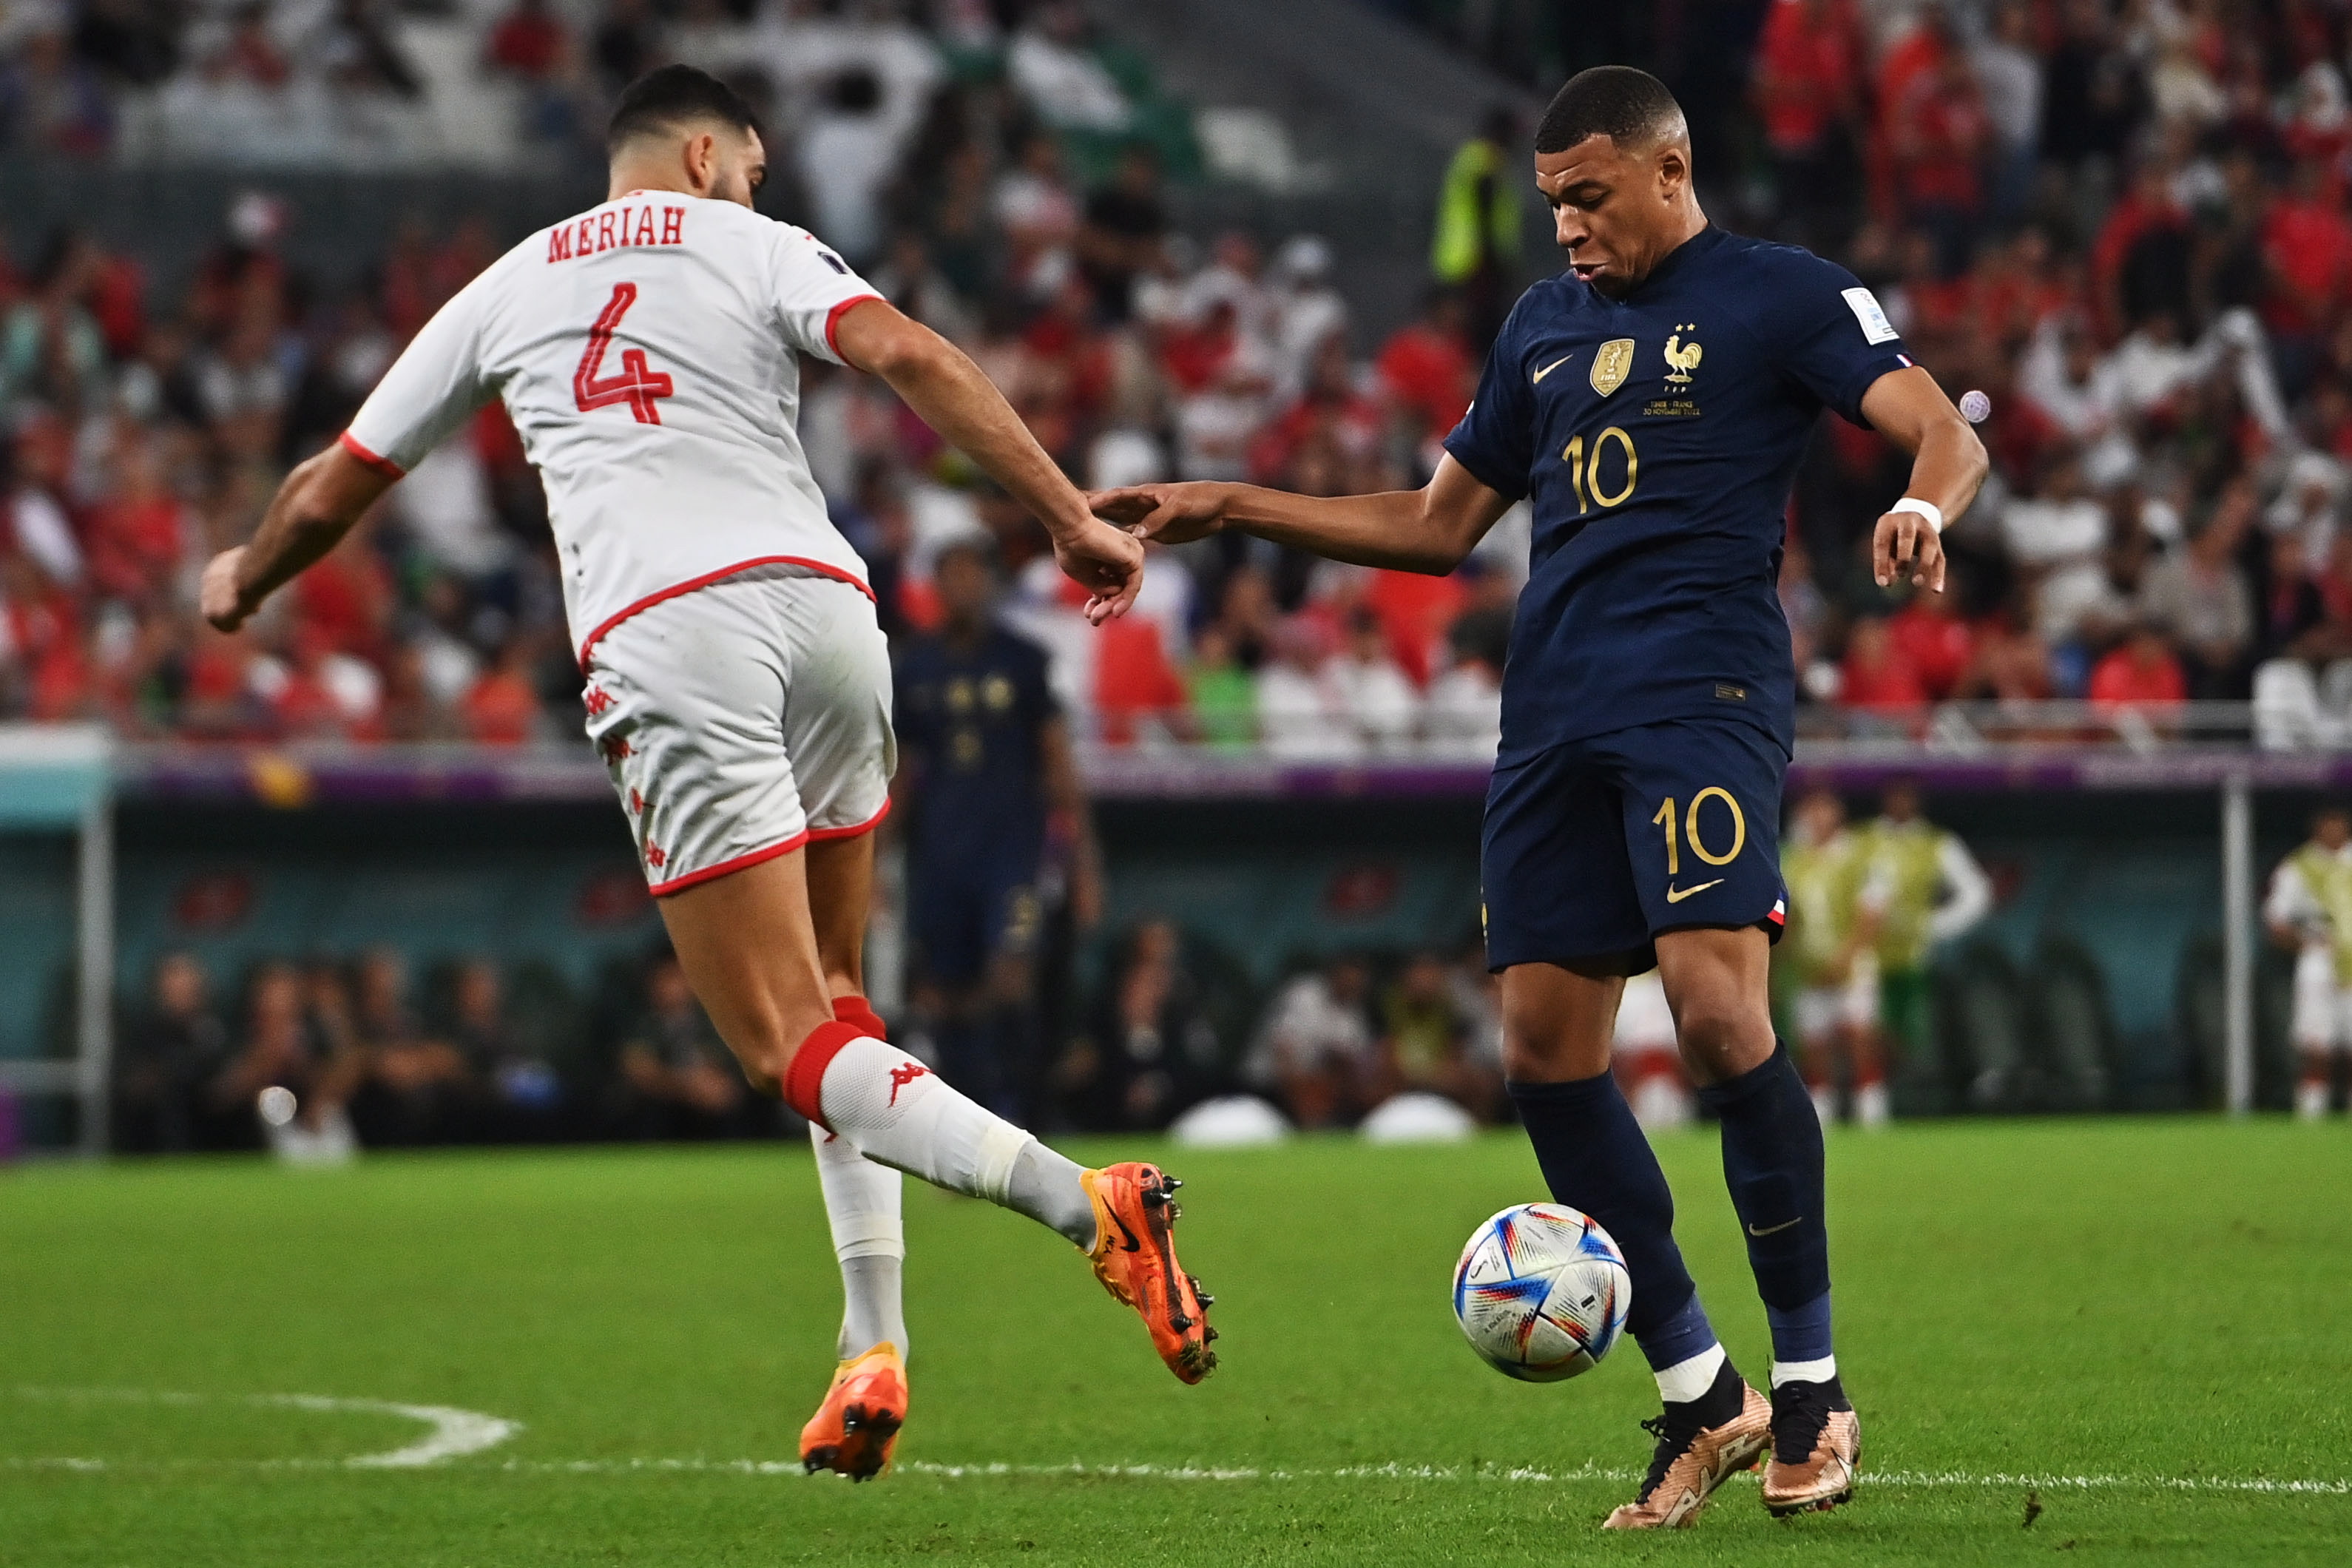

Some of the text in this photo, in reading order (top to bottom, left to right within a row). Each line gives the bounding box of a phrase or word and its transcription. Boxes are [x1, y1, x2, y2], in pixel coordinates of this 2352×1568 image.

[547, 205, 685, 263] MERIAH
[573, 281, 674, 425] 4
[1561, 426, 1638, 514] 10
[1652, 786, 1746, 875] 10
